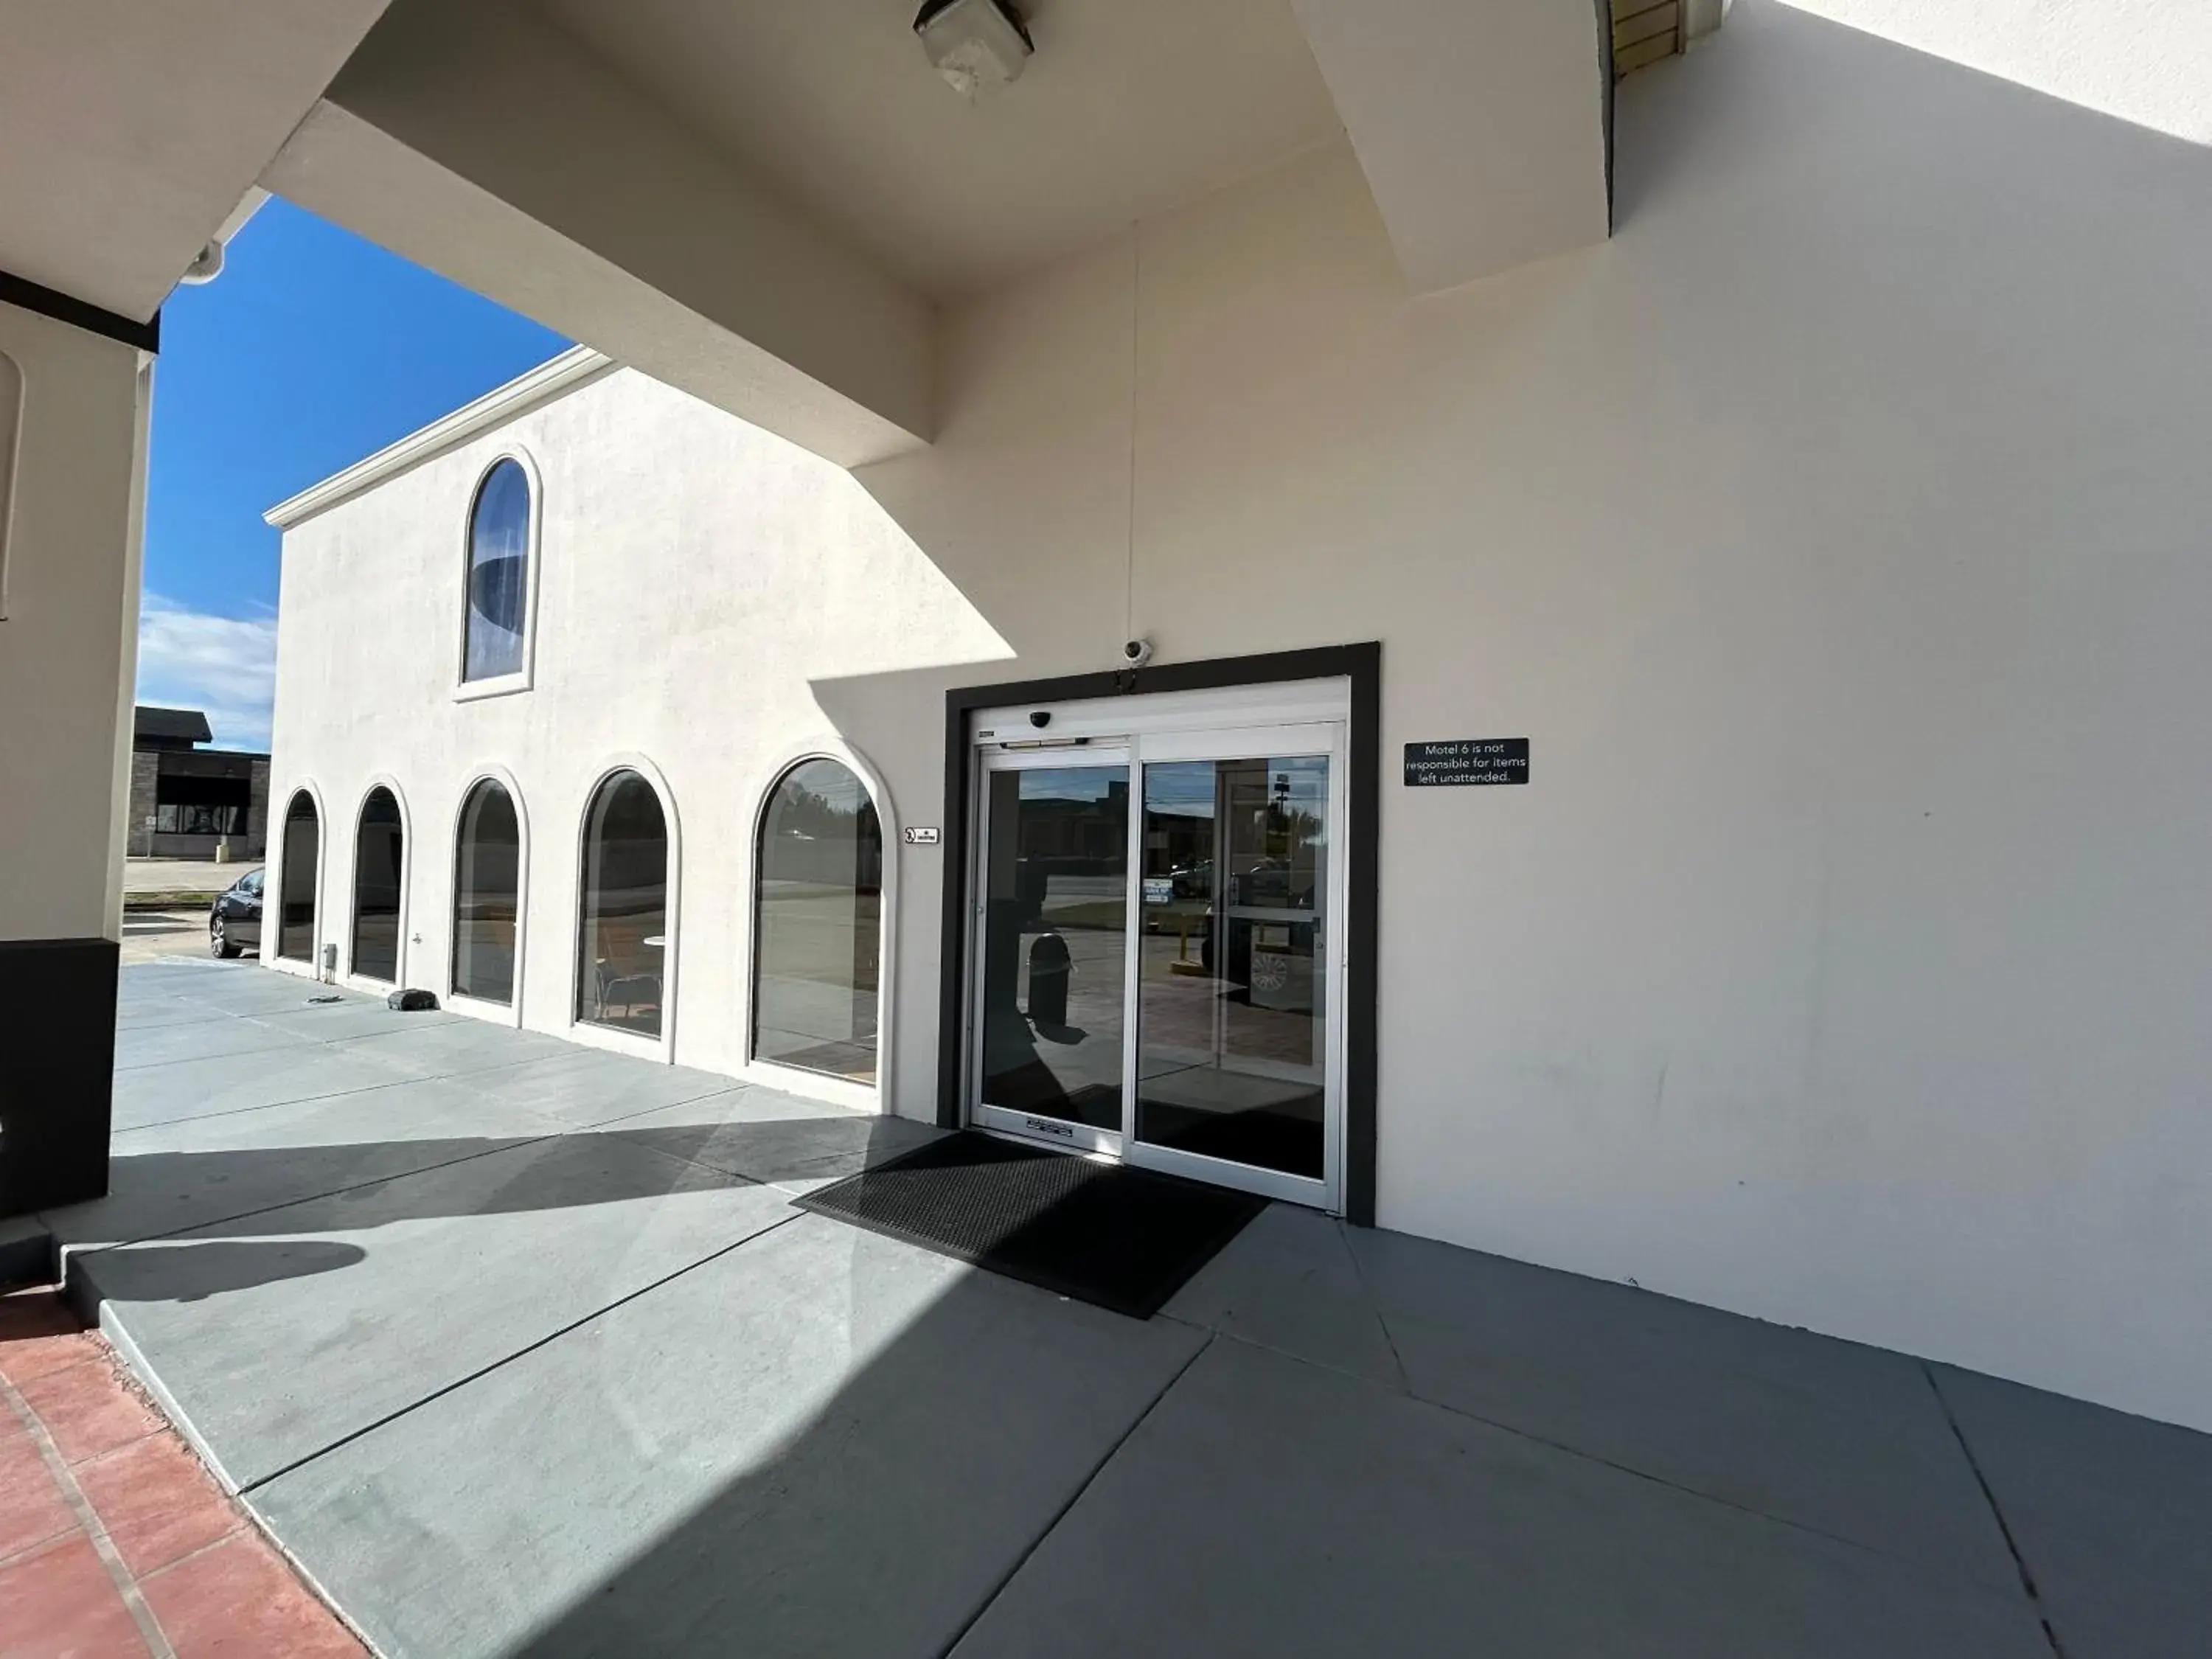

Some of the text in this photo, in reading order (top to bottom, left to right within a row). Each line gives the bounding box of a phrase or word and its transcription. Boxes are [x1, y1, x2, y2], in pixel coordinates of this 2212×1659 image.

[1425, 743, 1505, 755] Motel 6 is not
[1406, 757, 1470, 772] responsible
[1472, 757, 1489, 768] for
[1418, 771, 1511, 784] left unattended.
